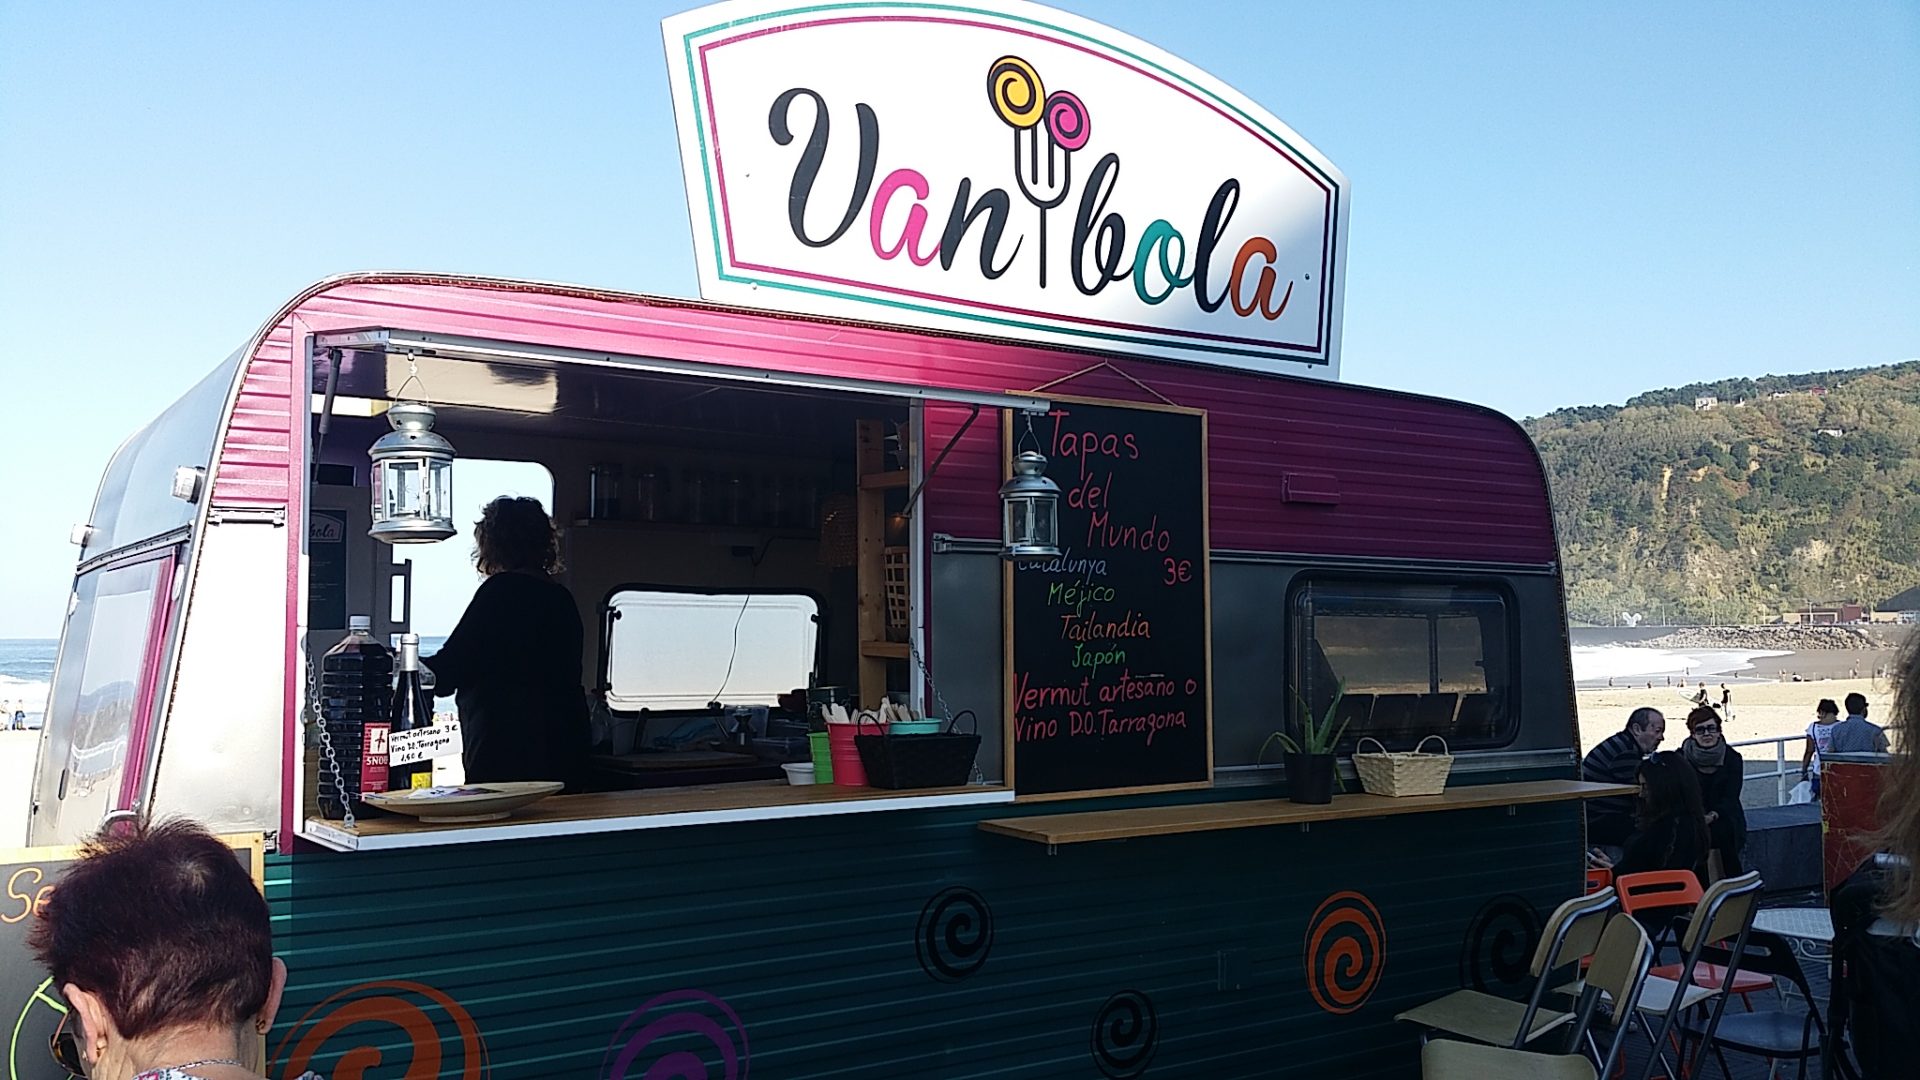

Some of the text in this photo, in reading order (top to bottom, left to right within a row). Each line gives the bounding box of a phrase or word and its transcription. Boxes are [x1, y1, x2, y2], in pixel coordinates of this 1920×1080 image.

[768, 87, 1294, 321] Van bola
[1048, 409, 1139, 480] Tapas
[1068, 472, 1112, 509] del
[1088, 511, 1170, 551] Mundo
[1164, 557, 1192, 585] 3€
[1048, 579, 1115, 617] Méjico
[1061, 610, 1151, 641] Tailandia
[1072, 642, 1126, 679] Japón
[1013, 672, 1091, 713] Vermut
[1099, 668, 1175, 702] artesano
[1014, 716, 1058, 742] Vino
[1097, 708, 1187, 746] Tarragona
